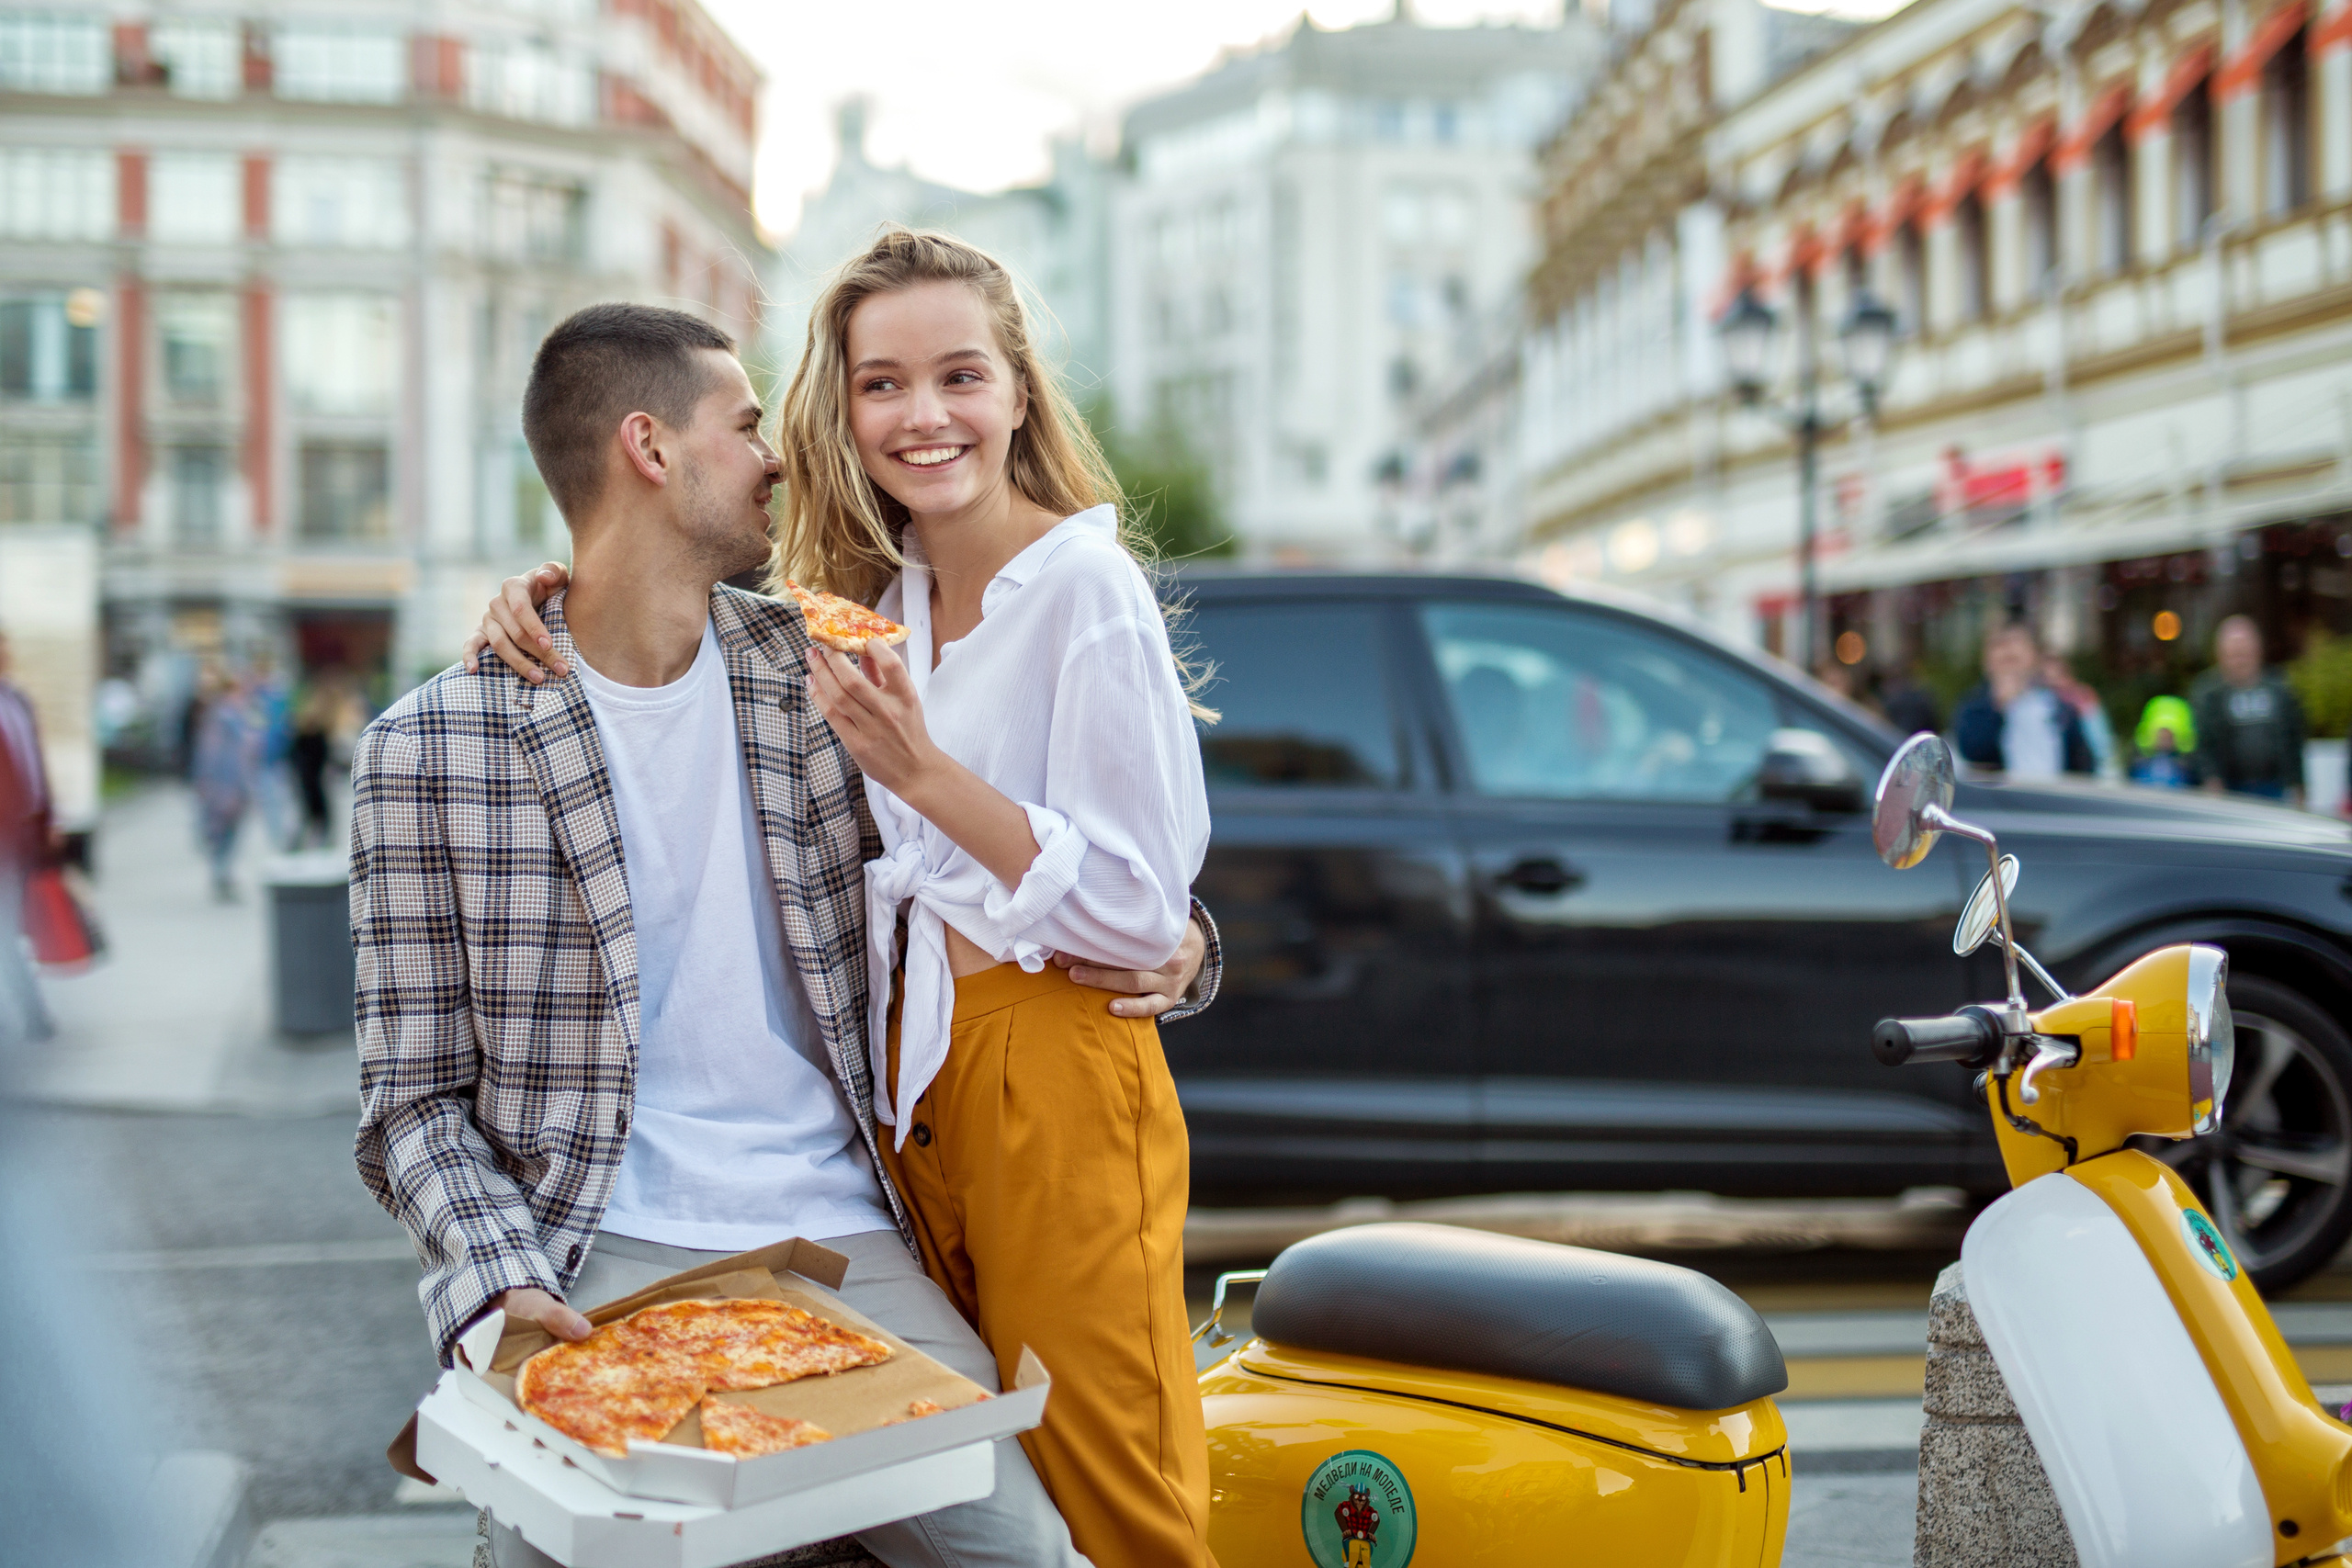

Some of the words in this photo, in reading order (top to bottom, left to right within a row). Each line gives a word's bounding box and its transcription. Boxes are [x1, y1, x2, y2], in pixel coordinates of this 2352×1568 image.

[1314, 1461, 1358, 1501] МЕДВЕДИ
[1360, 1462, 1373, 1476] НА
[1372, 1468, 1405, 1514] МОПЕДЕ
